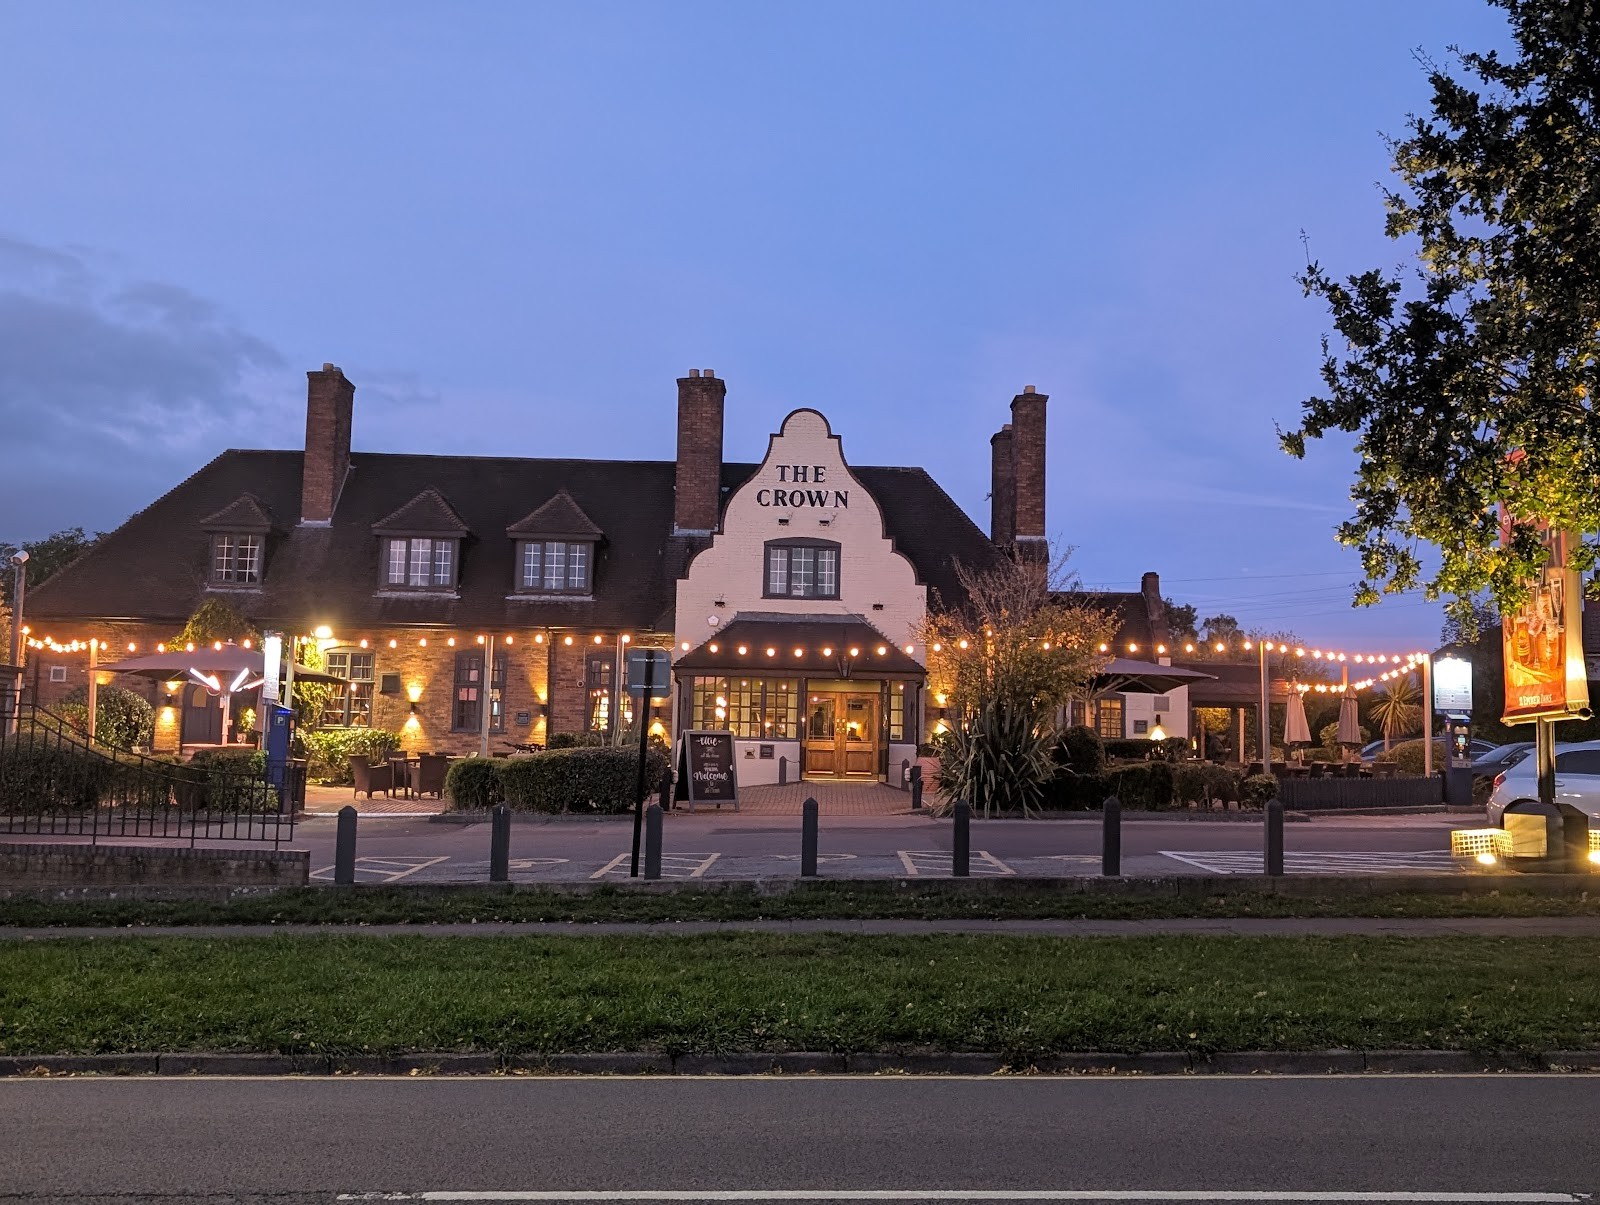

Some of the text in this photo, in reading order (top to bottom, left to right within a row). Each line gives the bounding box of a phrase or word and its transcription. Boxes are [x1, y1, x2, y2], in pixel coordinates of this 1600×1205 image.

[776, 465, 826, 483] THE
[756, 489, 849, 509] CROWN
[693, 770, 728, 781] Welcome
